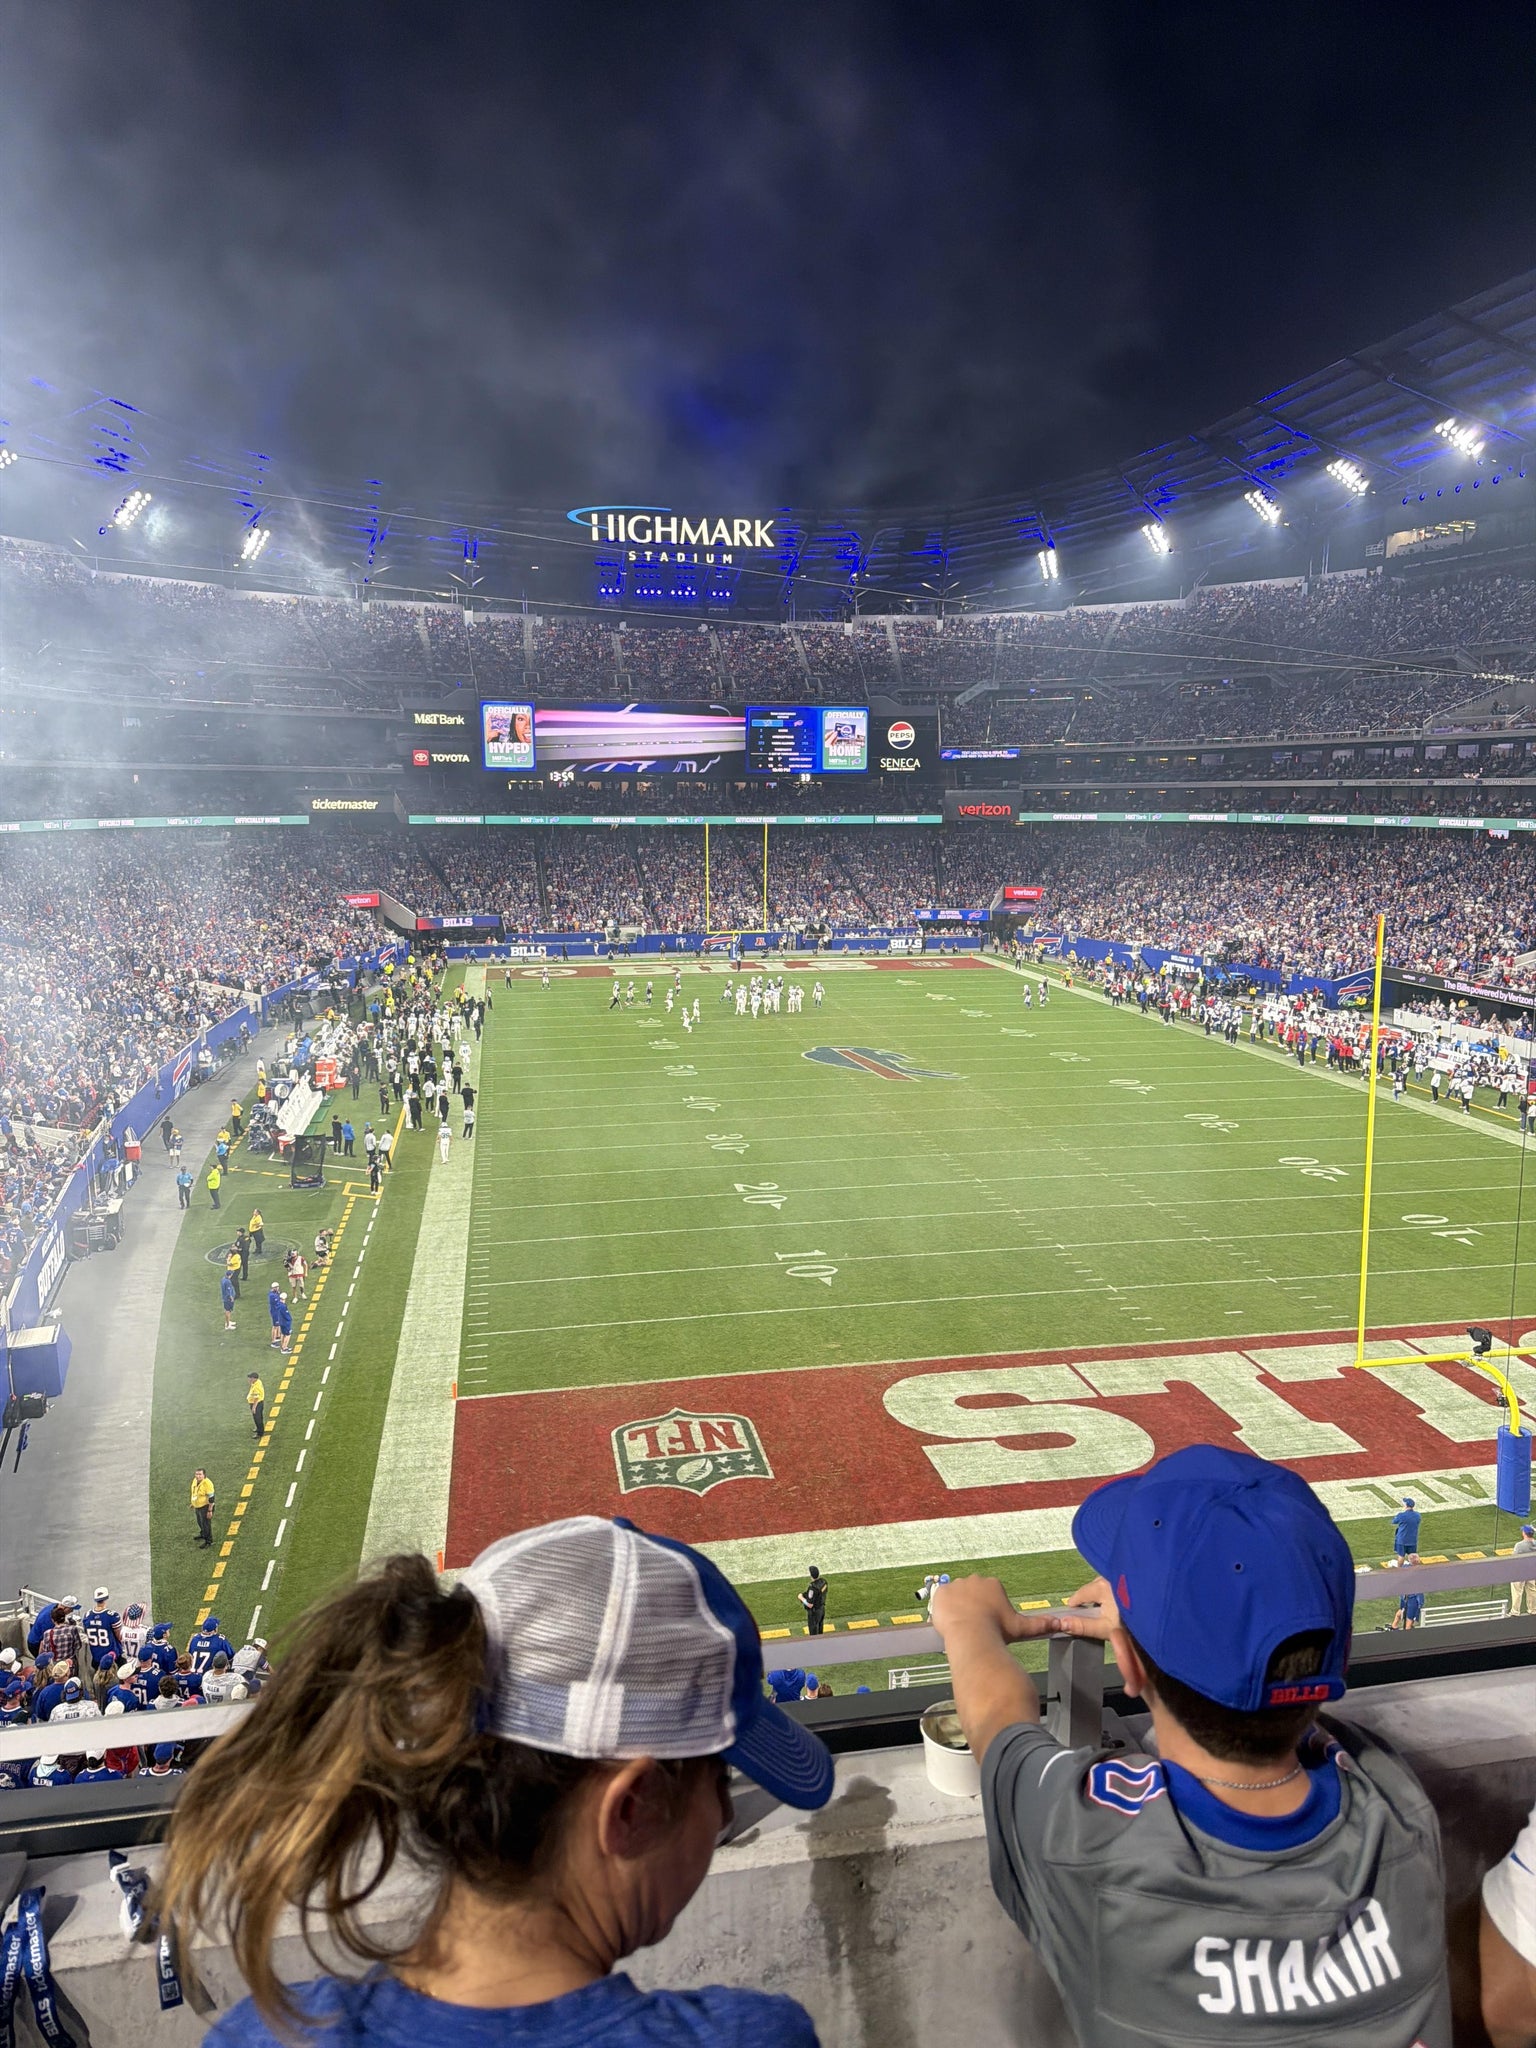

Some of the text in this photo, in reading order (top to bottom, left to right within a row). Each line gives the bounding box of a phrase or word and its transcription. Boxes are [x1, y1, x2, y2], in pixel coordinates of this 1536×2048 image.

[591, 513, 775, 547] HIGHMARK
[628, 551, 732, 564] STADIUM
[489, 742, 530, 753] HYPED
[829, 746, 861, 757] HOME
[431, 754, 470, 763] TOYOTA
[880, 758, 920, 768] SENECA
[550, 771, 574, 781] 13:59
[312, 799, 378, 809] ticketmaster
[958, 803, 1011, 815] verizon
[1013, 889, 1037, 897] verizon
[442, 918, 473, 927] BILLS
[510, 946, 546, 957] BILLS
[890, 938, 922, 949] BILLS
[1444, 979, 1456, 990] The
[1457, 981, 1471, 993] Bills
[1471, 985, 1499, 999] powered
[1500, 989, 1508, 1001] by
[1508, 992, 1534, 1005] Verizon
[705, 1133, 749, 1151] 30
[1278, 1157, 1349, 1176] 20
[733, 1182, 787, 1205] 20
[1401, 1214, 1484, 1238] 10
[774, 1250, 838, 1278] 10
[628, 1420, 745, 1459] NFL
[1345, 1474, 1489, 1508] ALL
[87, 1628, 110, 1647] 58
[124, 1641, 138, 1658] 17
[190, 1652, 210, 1673] 17
[133, 1687, 148, 1705] 91
[1270, 1684, 1329, 1704] BILLS
[65, 1712, 80, 1720] ALLEN
[26, 1911, 48, 1992] ticketmaster
[1194, 1898, 1401, 2014] SHAKIR
[38, 1998, 59, 2036] BILLS
